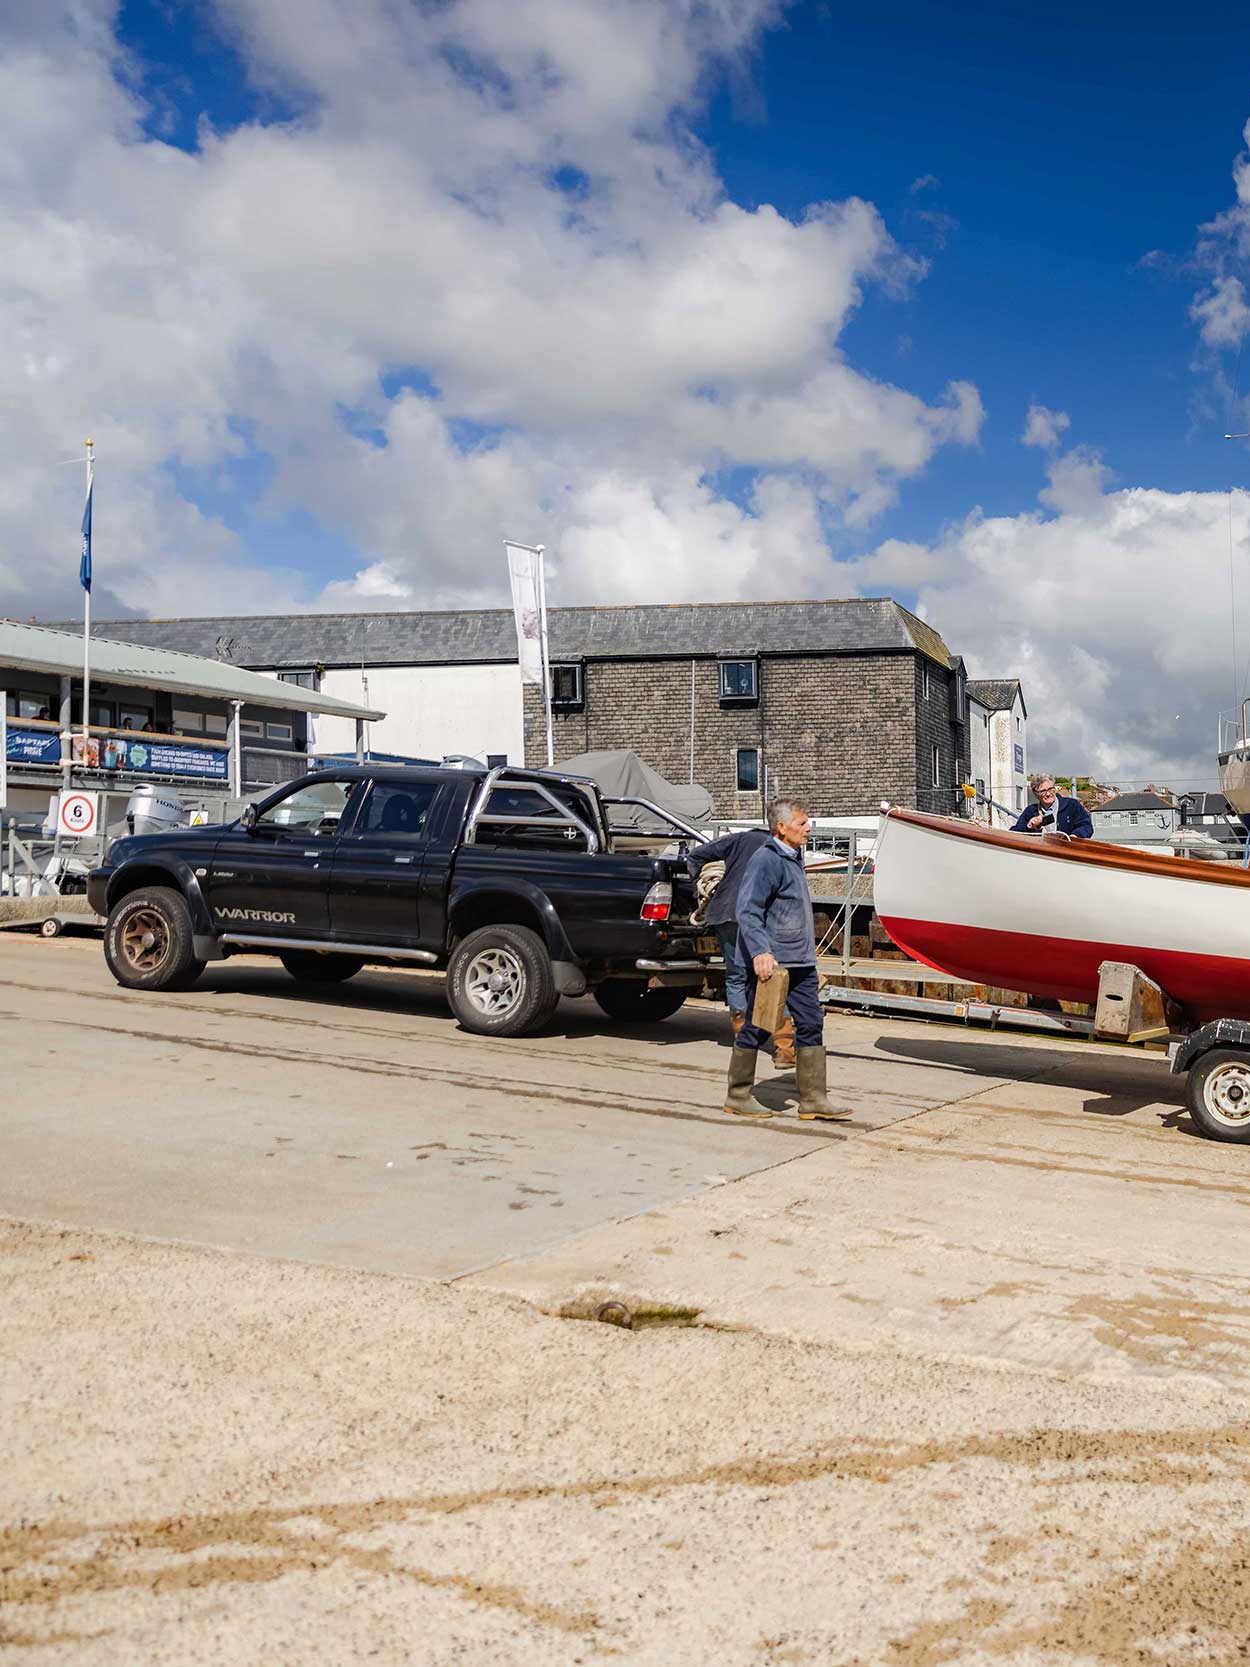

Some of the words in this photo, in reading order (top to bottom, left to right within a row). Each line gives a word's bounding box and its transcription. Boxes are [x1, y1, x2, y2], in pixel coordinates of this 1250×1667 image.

[73, 805, 82, 818] 6
[156, 799, 185, 813] HONDA
[214, 906, 296, 924] WARRIOR
